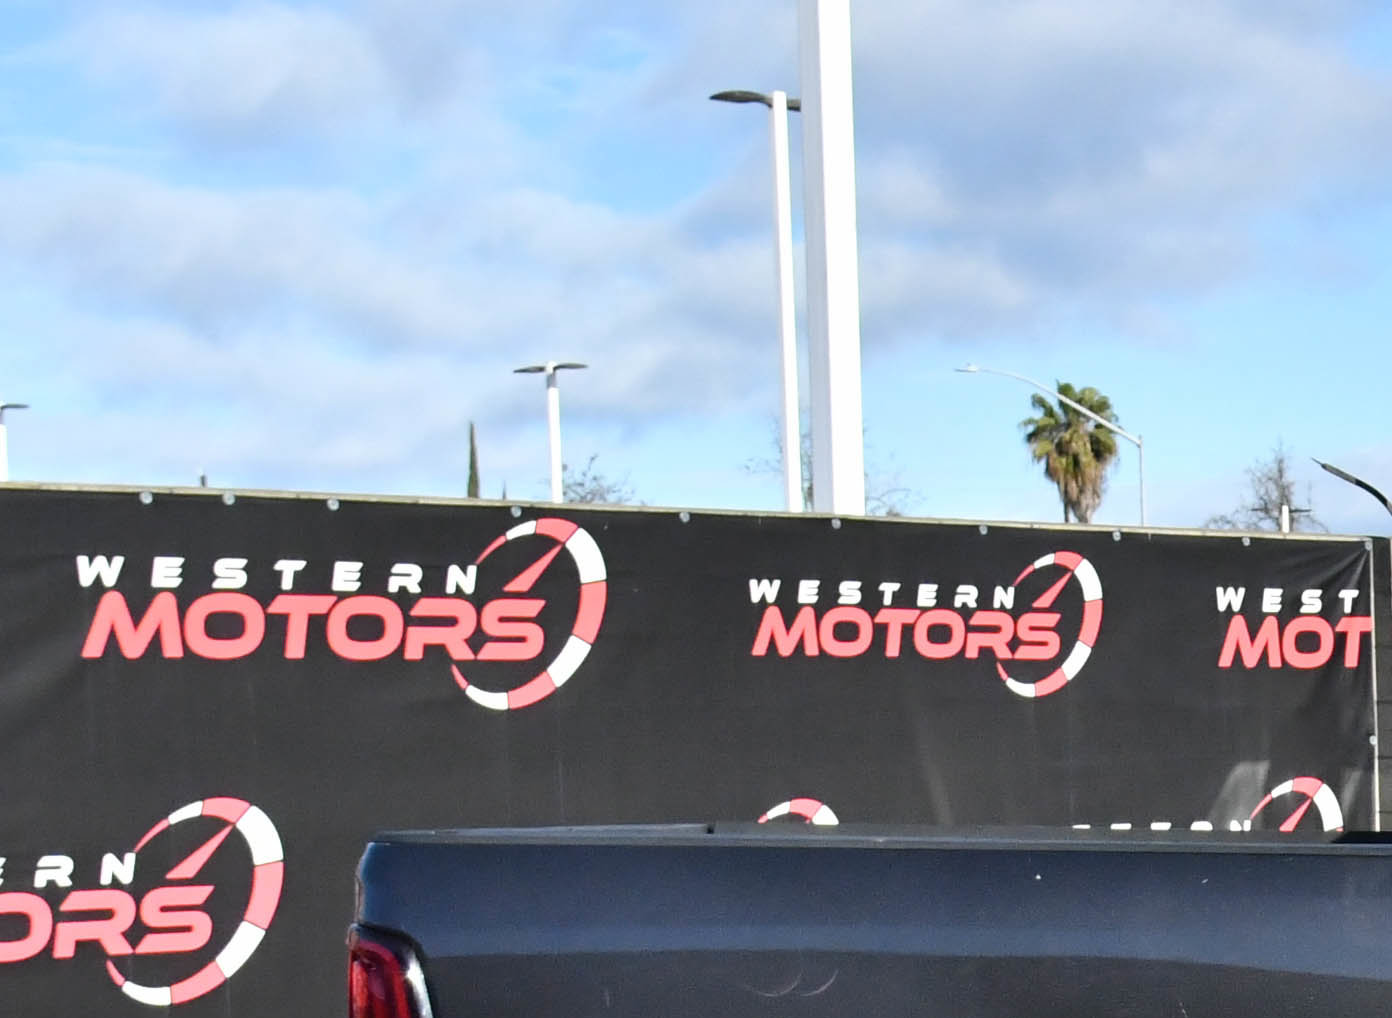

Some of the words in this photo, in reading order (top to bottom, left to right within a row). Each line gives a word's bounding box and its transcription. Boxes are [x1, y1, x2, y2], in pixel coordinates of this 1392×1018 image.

[76, 555, 478, 594] WESTERN
[749, 578, 1015, 608] WESTERN
[1216, 587, 1360, 614] WEST
[81, 590, 547, 662] MOTORS
[751, 605, 1062, 660] MOTORS
[1217, 614, 1373, 670] MOT
[0, 852, 137, 889] RN
